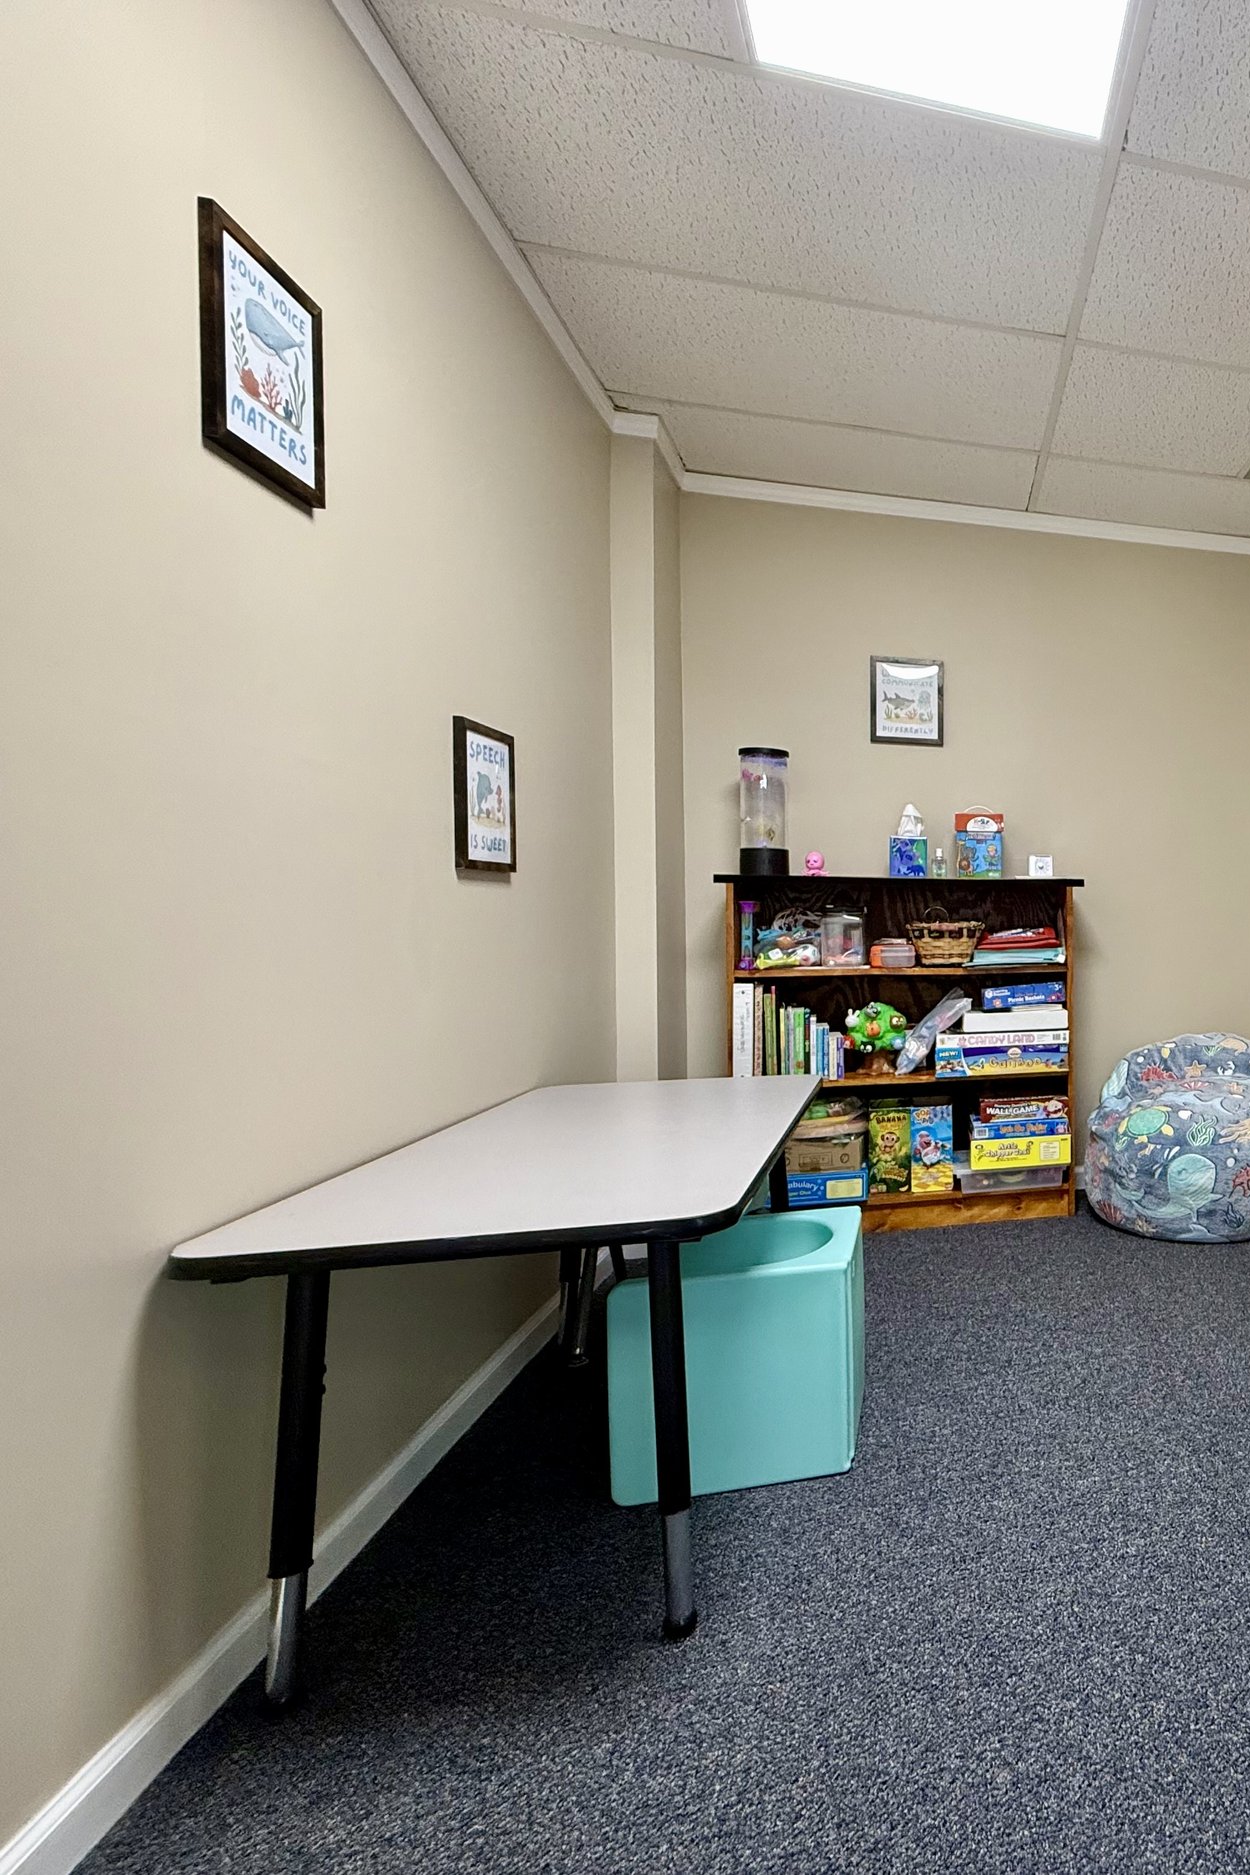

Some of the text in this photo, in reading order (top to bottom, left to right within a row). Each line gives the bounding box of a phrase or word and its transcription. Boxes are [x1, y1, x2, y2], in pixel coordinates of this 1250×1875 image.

[228, 249, 306, 337] YOUR VOICE
[231, 394, 308, 466] MATTERS
[882, 725, 934, 735] DIFFERENTLY
[469, 740, 505, 769] SPEECH
[470, 834, 506, 853] IS SWEET
[967, 1034, 1005, 1046] CANDY
[1007, 1033, 1035, 1044] LAND
[986, 1105, 1039, 1115] WALL GAME
[876, 1114, 907, 1125] BANANA
[788, 1181, 819, 1191] abulary
